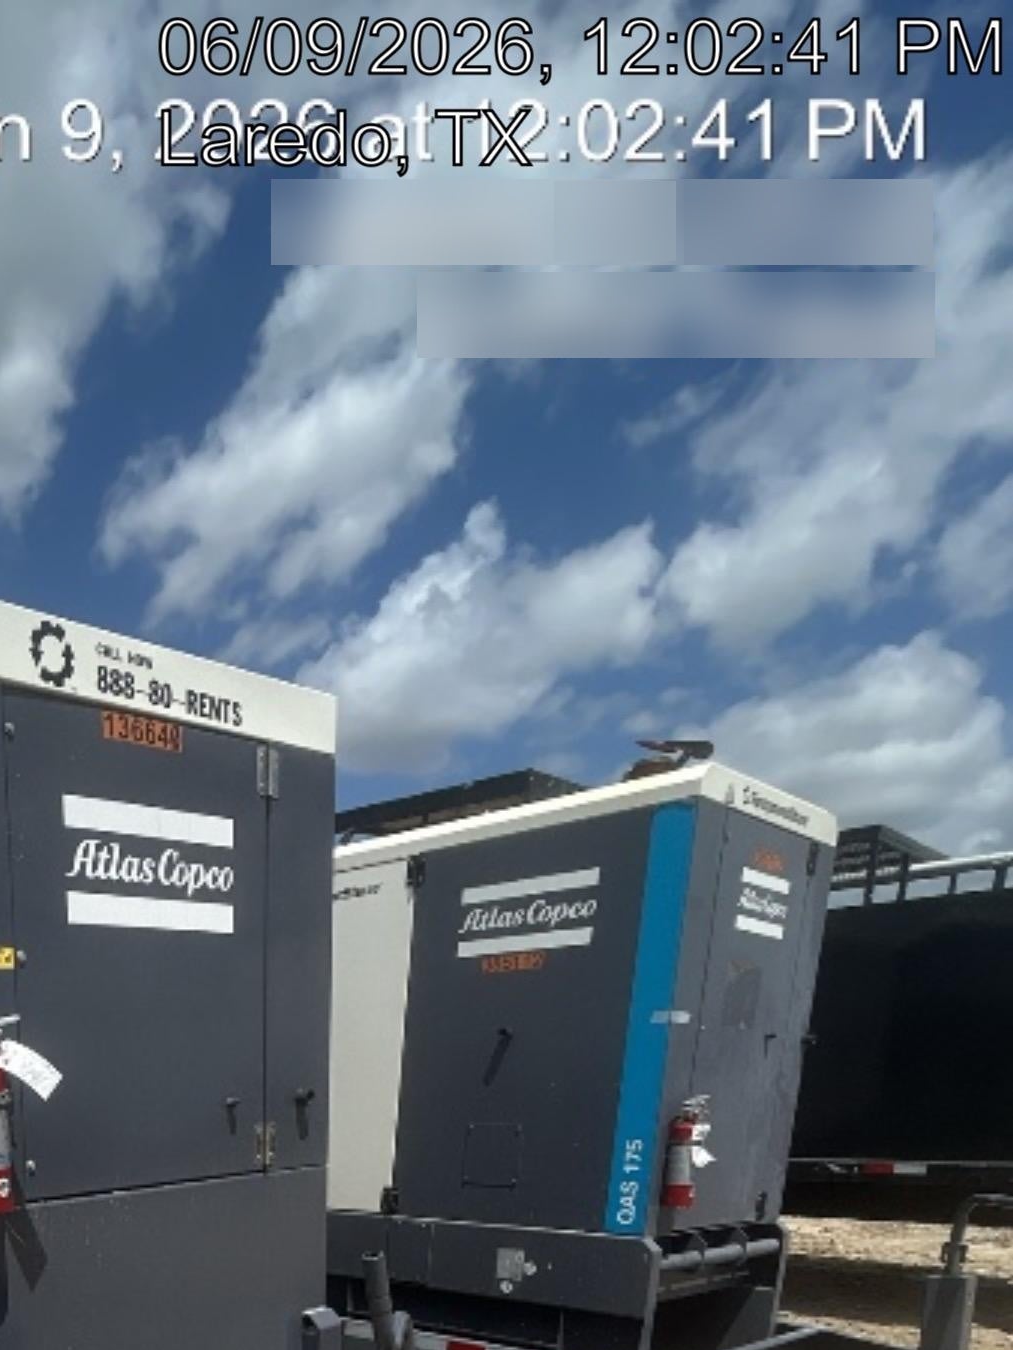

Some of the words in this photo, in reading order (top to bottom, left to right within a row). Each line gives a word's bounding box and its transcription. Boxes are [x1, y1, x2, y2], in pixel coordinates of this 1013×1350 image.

[64, 839, 156, 883] Atlas
[157, 848, 234, 897] Copco
[623, 1138, 643, 1174] 175
[616, 1181, 639, 1225] QAS
